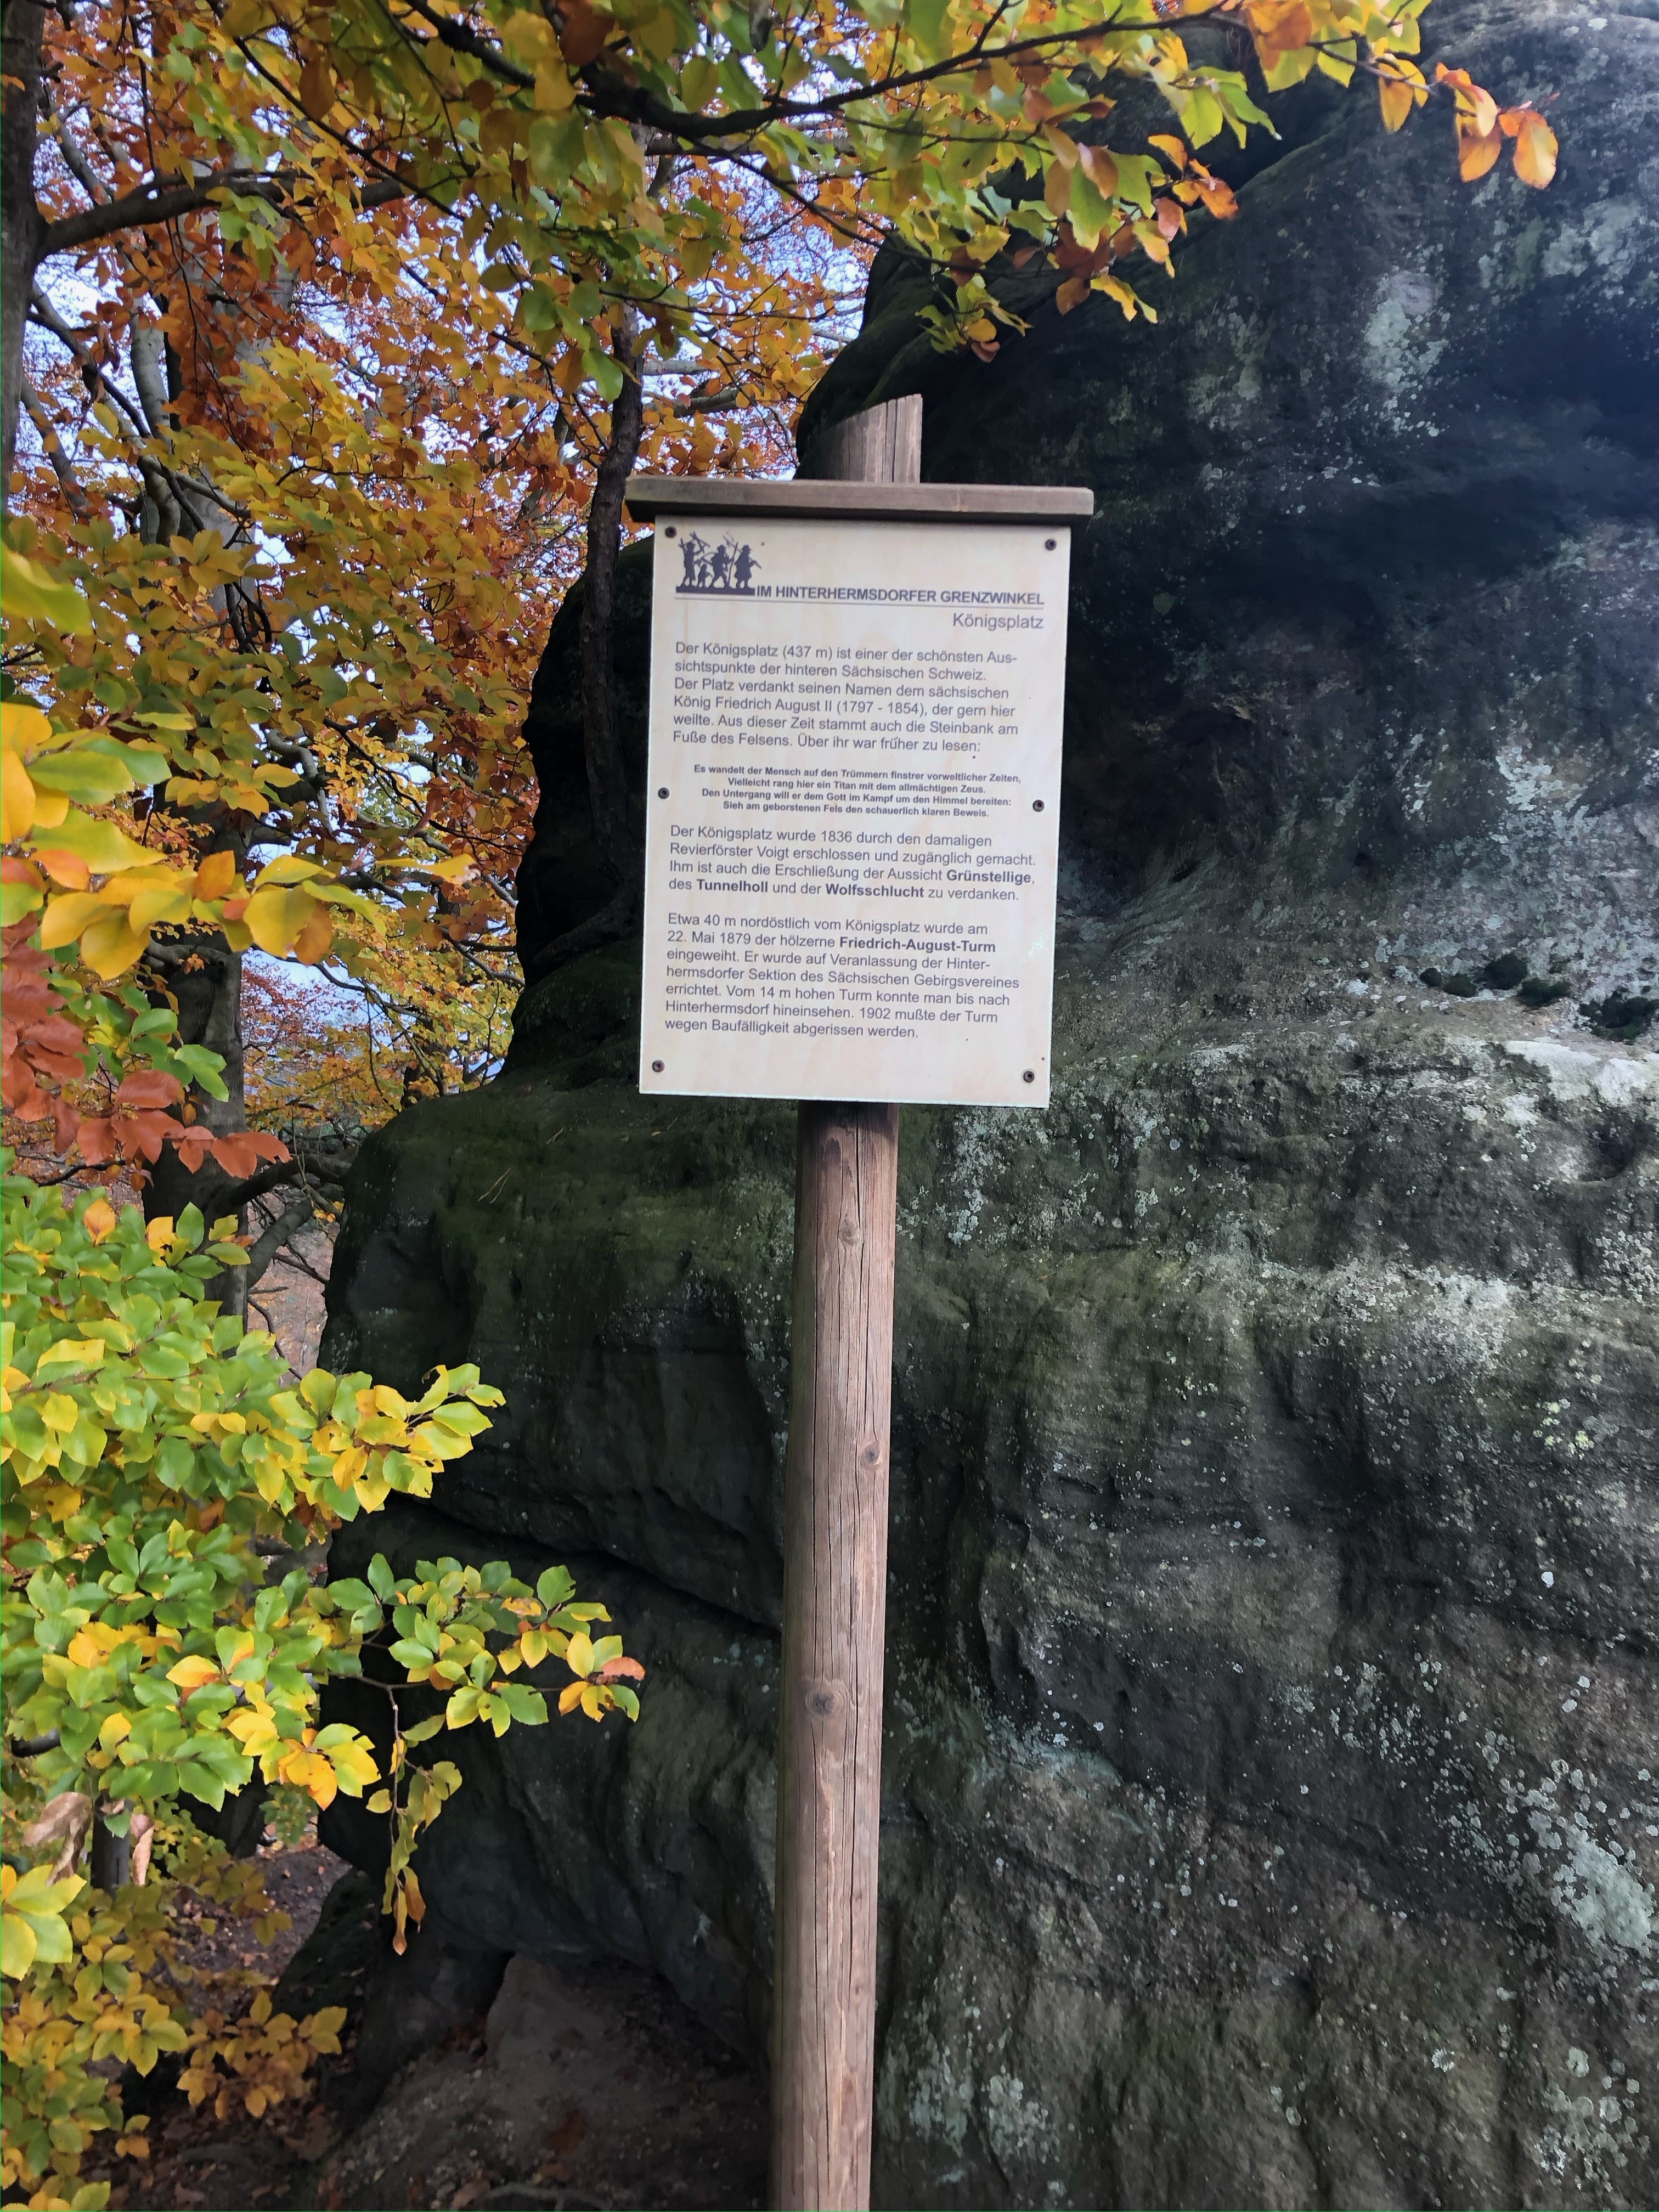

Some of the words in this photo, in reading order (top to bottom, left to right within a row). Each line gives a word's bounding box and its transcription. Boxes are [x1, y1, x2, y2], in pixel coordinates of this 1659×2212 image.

[757, 585, 772, 597] IM
[775, 586, 936, 601] HINTERHERMSDORFER
[940, 590, 1045, 605] GRENZWINKEL
[953, 613, 1043, 631] Königsplatz
[676, 641, 699, 654] Der
[703, 642, 778, 659] Königsplatz
[782, 645, 811, 660] (437
[816, 647, 833, 661] m)
[837, 647, 851, 659] ist
[855, 648, 888, 660] einer
[891, 648, 913, 661] der
[917, 650, 983, 663] schönsten
[986, 651, 1017, 663] Aus-
[675, 659, 755, 675] sichtspunkte
[760, 662, 781, 675] der
[785, 663, 837, 676] hinteren
[842, 665, 924, 679] Sächsischen
[929, 667, 986, 680] Schweiz.
[675, 677, 698, 690] Der
[702, 678, 735, 691] Platz
[738, 680, 794, 693] verdankt
[798, 682, 841, 695] seinen
[845, 682, 891, 696] Namen
[896, 685, 924, 697] dem
[928, 686, 1009, 699] sächsischen
[674, 695, 711, 710] König
[715, 696, 771, 710] Friedrich
[775, 698, 821, 714] August
[825, 700, 832, 712] II
[837, 700, 874, 715] (1797
[888, 702, 927, 718] 1854),
[932, 703, 954, 715] der
[957, 707, 986, 719] gern
[991, 704, 1015, 717] hier
[673, 713, 714, 726] weilte.
[717, 714, 743, 727] Aus
[747, 715, 787, 728] dieser
[790, 716, 815, 729] Zeit
[819, 719, 866, 731] stammt
[870, 720, 902, 732] auch
[906, 720, 926, 732] die
[929, 721, 994, 735] Steinbank
[998, 725, 1018, 735] am
[673, 730, 707, 743] Fuße
[710, 732, 735, 744] des
[738, 732, 793, 747] Felsens.
[798, 732, 830, 747] Über
[833, 736, 850, 748] ihr
[853, 739, 877, 749] war
[922, 741, 938, 751] zu
[942, 739, 980, 752] lesen:
[694, 764, 706, 772] Es
[708, 766, 745, 774] wandelt
[747, 766, 763, 775] der
[765, 767, 801, 776] Mensch
[804, 768, 819, 776] auf
[821, 769, 838, 777] den
[840, 769, 888, 778] Trümmern
[890, 771, 925, 780] finstrer
[927, 772, 988, 781] vorweltlicher
[989, 774, 1021, 783] Zeiten,
[702, 788, 720, 797] Den
[723, 789, 771, 801] Untergang
[774, 791, 789, 799] will
[804, 792, 824, 801] dem
[826, 792, 847, 802] Gott
[849, 793, 860, 802] im
[863, 794, 894, 804] Kampf
[913, 795, 930, 804] den
[933, 795, 968, 805] Himmel
[970, 797, 1012, 806] bereiten:
[670, 825, 695, 837] Der
[698, 826, 773, 842] Königsplatz
[776, 830, 816, 842] wurde
[821, 830, 853, 843] 1836
[856, 832, 893, 844] durch
[896, 833, 921, 845] den
[925, 833, 992, 849] damaligen
[670, 842, 753, 857] Revierförster
[757, 845, 789, 861] Voigt
[793, 848, 870, 861] erschlossen
[874, 850, 899, 862] und
[902, 851, 972, 866] zugänglich
[976, 854, 1036, 867] gemacht.
[670, 859, 693, 873] Ihm
[698, 861, 712, 873] ist
[716, 862, 747, 874] auch
[751, 863, 771, 875] die
[775, 864, 859, 881] Erschließung
[863, 867, 885, 879] der
[887, 868, 943, 881] Aussicht
[946, 870, 1035, 886] Grünstellige,
[669, 878, 692, 890] des
[696, 878, 768, 893] Tunnelholl
[772, 882, 796, 894] und
[800, 882, 822, 894] der
[825, 883, 924, 898] Wolfsschlucht
[928, 889, 943, 898] zu
[947, 888, 1019, 900] verdanken.
[668, 912, 700, 925] Etwa
[703, 914, 720, 926] 40
[724, 917, 736, 927] m
[741, 916, 810, 929] nordöstlich
[814, 921, 841, 930] vom
[845, 919, 920, 935] Königsplatz
[924, 922, 963, 934] wurde
[968, 926, 988, 935] am
[667, 930, 687, 943] 22.
[692, 930, 715, 944] Mai
[720, 932, 751, 945] 1879
[755, 933, 777, 945] der
[780, 934, 836, 947] hölzerne
[839, 936, 996, 953] Friedrich-August-Turm
[667, 948, 740, 963] eingeweiht.
[744, 950, 759, 962] Er
[762, 952, 802, 964] wurde
[805, 953, 827, 965] auf
[830, 953, 917, 970] Veranlassung
[922, 957, 943, 968] der
[947, 957, 990, 970] Hinter-
[667, 965, 745, 979] hermsdorfer
[748, 968, 796, 981] Sektion
[800, 970, 823, 983] des
[828, 970, 909, 985] Sächsischen
[914, 974, 1019, 990] Gebirgsvereines
[665, 983, 721, 996] errichtet.
[726, 985, 755, 997] Vom
[760, 986, 775, 998] 14
[779, 989, 791, 998] m
[795, 988, 835, 1000] hohen
[839, 989, 872, 1001] Turm
[876, 990, 919, 1002] konnte
[924, 995, 951, 1004] man
[956, 992, 974, 1005] bis
[979, 994, 1009, 1006] nach
[666, 1000, 770, 1015] Hinterhermsdorf
[773, 1004, 854, 1018] hineinsehen.
[860, 1007, 891, 1019] 1902
[895, 1008, 936, 1021] mußte
[940, 1010, 962, 1022] der
[964, 1011, 998, 1023] Turm
[664, 1020, 707, 1032] wegen
[712, 1019, 789, 1035] Baufälligkeit
[793, 1022, 864, 1037] abgerissen
[867, 1026, 918, 1038] werden.
